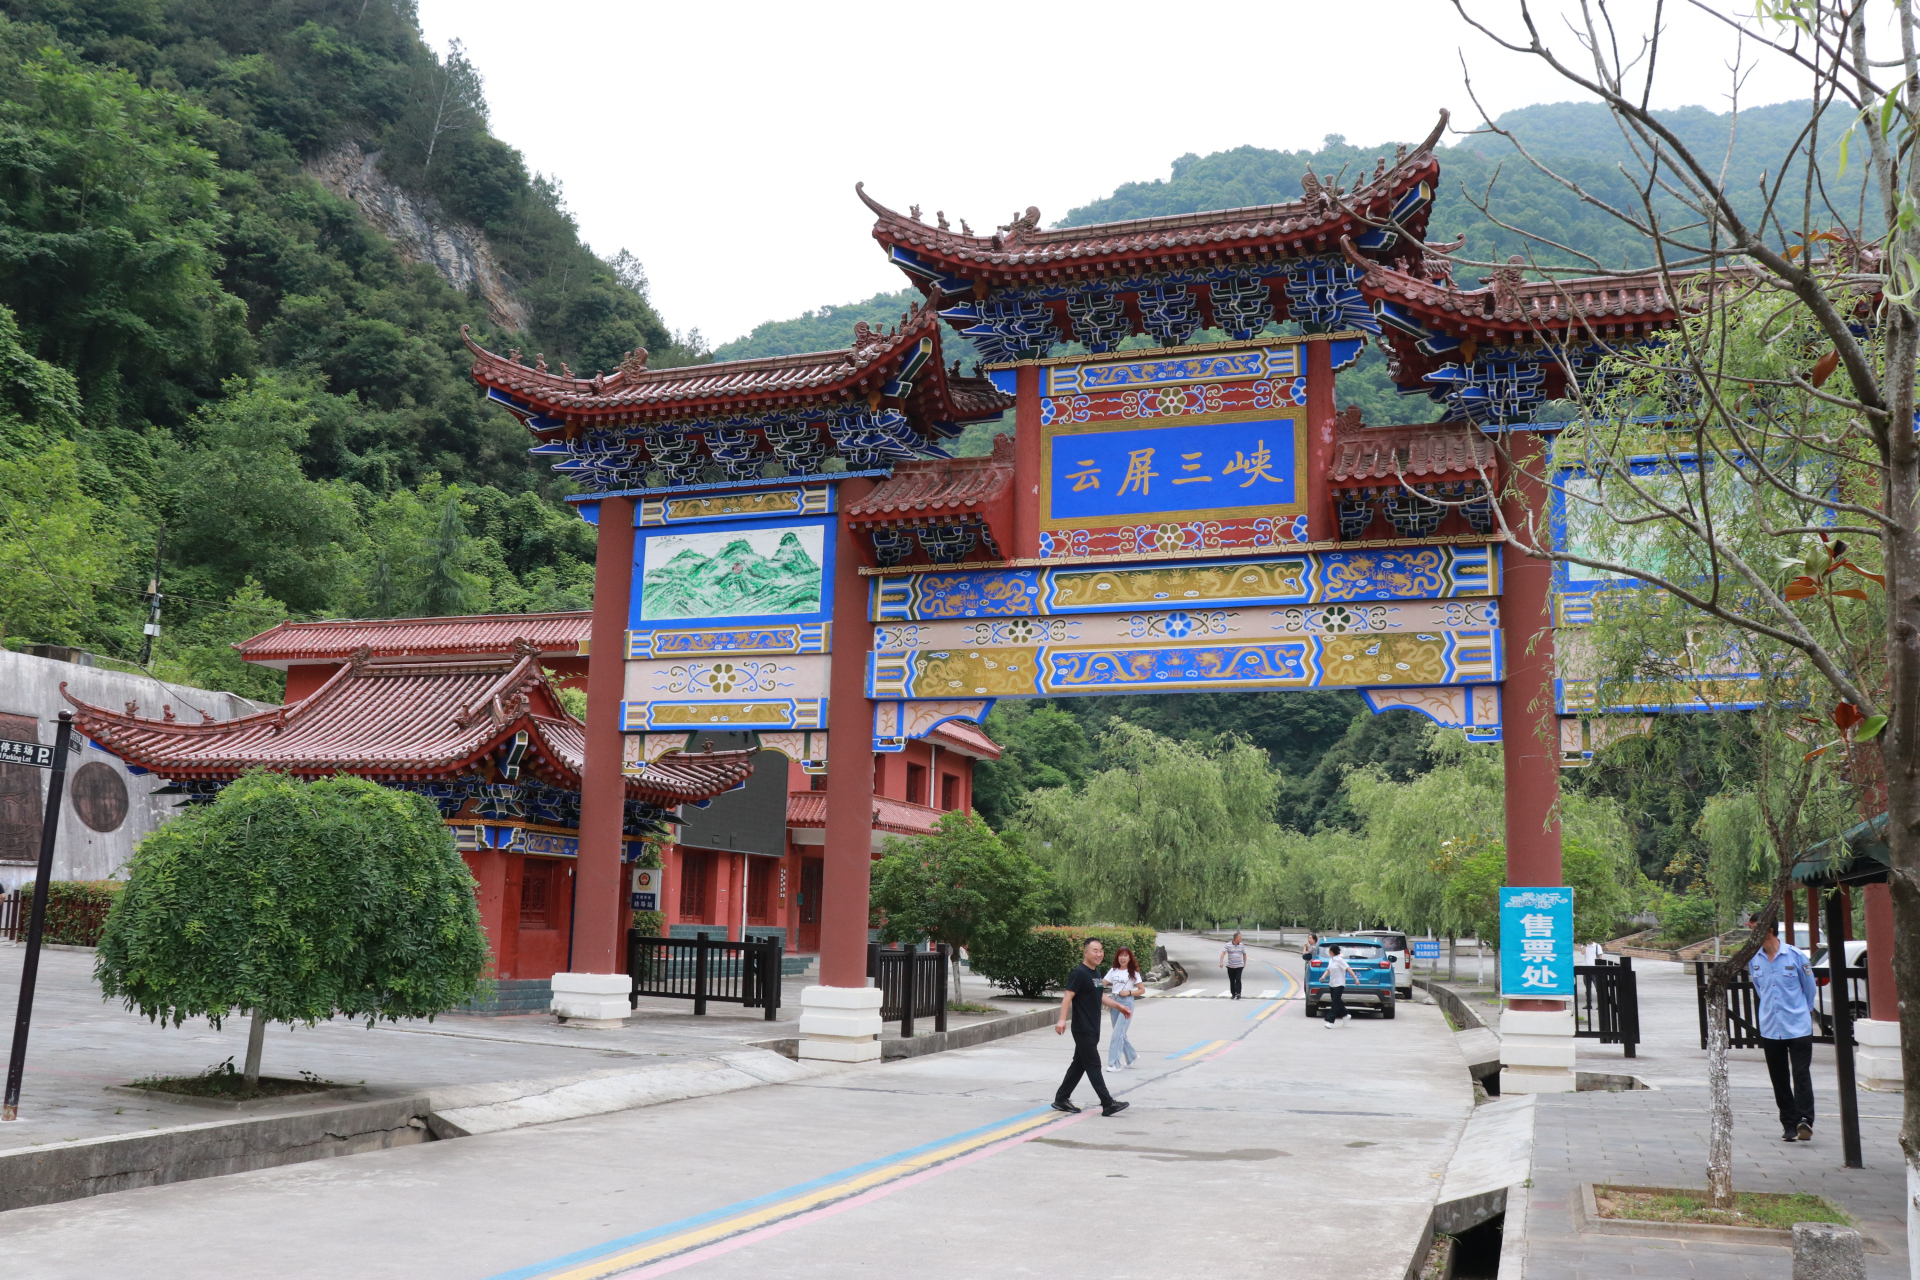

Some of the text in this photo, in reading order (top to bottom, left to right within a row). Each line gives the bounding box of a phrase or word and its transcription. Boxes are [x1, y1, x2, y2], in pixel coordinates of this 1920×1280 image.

[1065, 439, 1284, 496] 云屏三峡
[0, 742, 34, 756] 停车场
[2, 752, 22, 763] Parking
[22, 755, 32, 763] Lot
[1506, 892, 1566, 909] 温馨提示
[1519, 913, 1559, 988] 售票处
